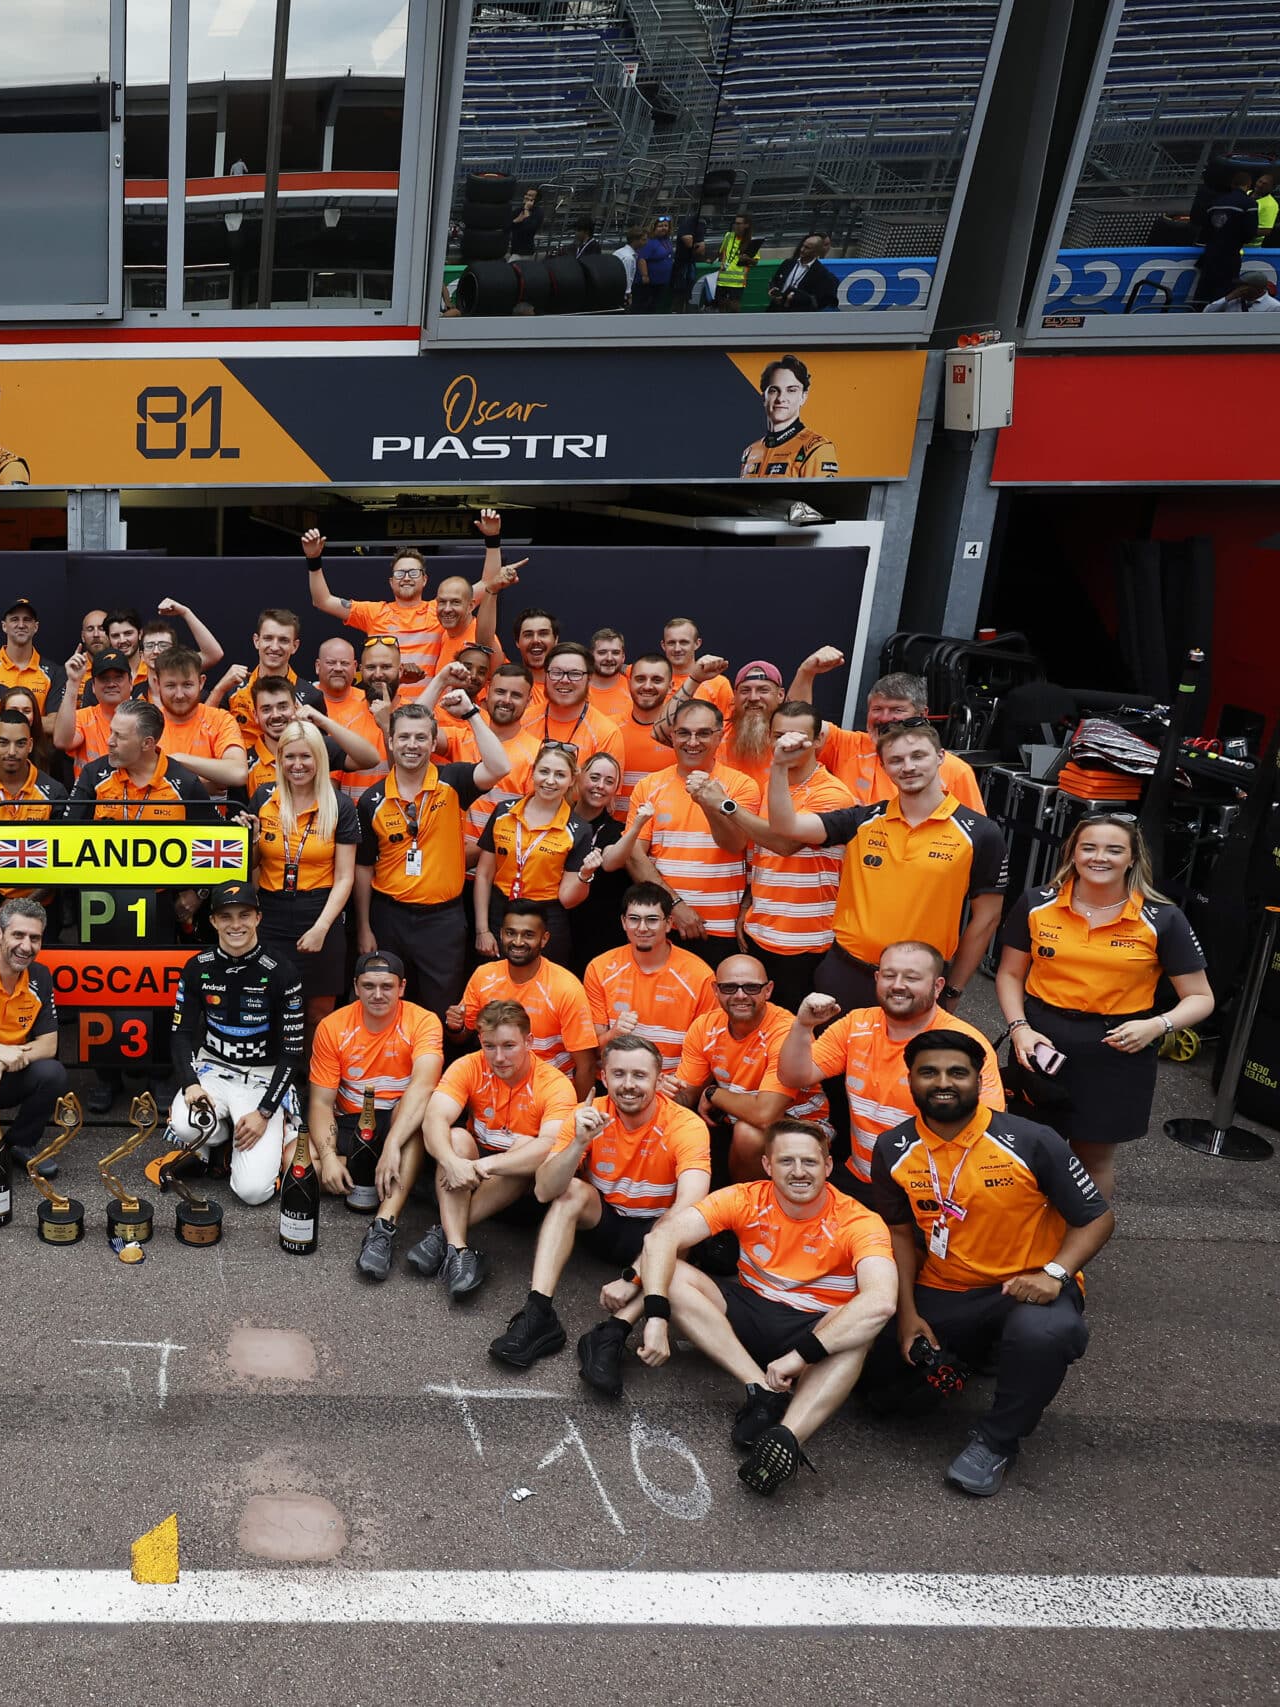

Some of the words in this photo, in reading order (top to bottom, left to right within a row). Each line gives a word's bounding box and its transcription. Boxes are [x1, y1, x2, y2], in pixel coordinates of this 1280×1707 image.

[442, 375, 548, 433] Oscar
[136, 386, 241, 459] 81
[371, 434, 608, 460] PIASTRI
[967, 544, 978, 557] 4
[53, 838, 187, 868] LANDO
[201, 982, 226, 992] Android
[206, 1030, 267, 1059] OKX
